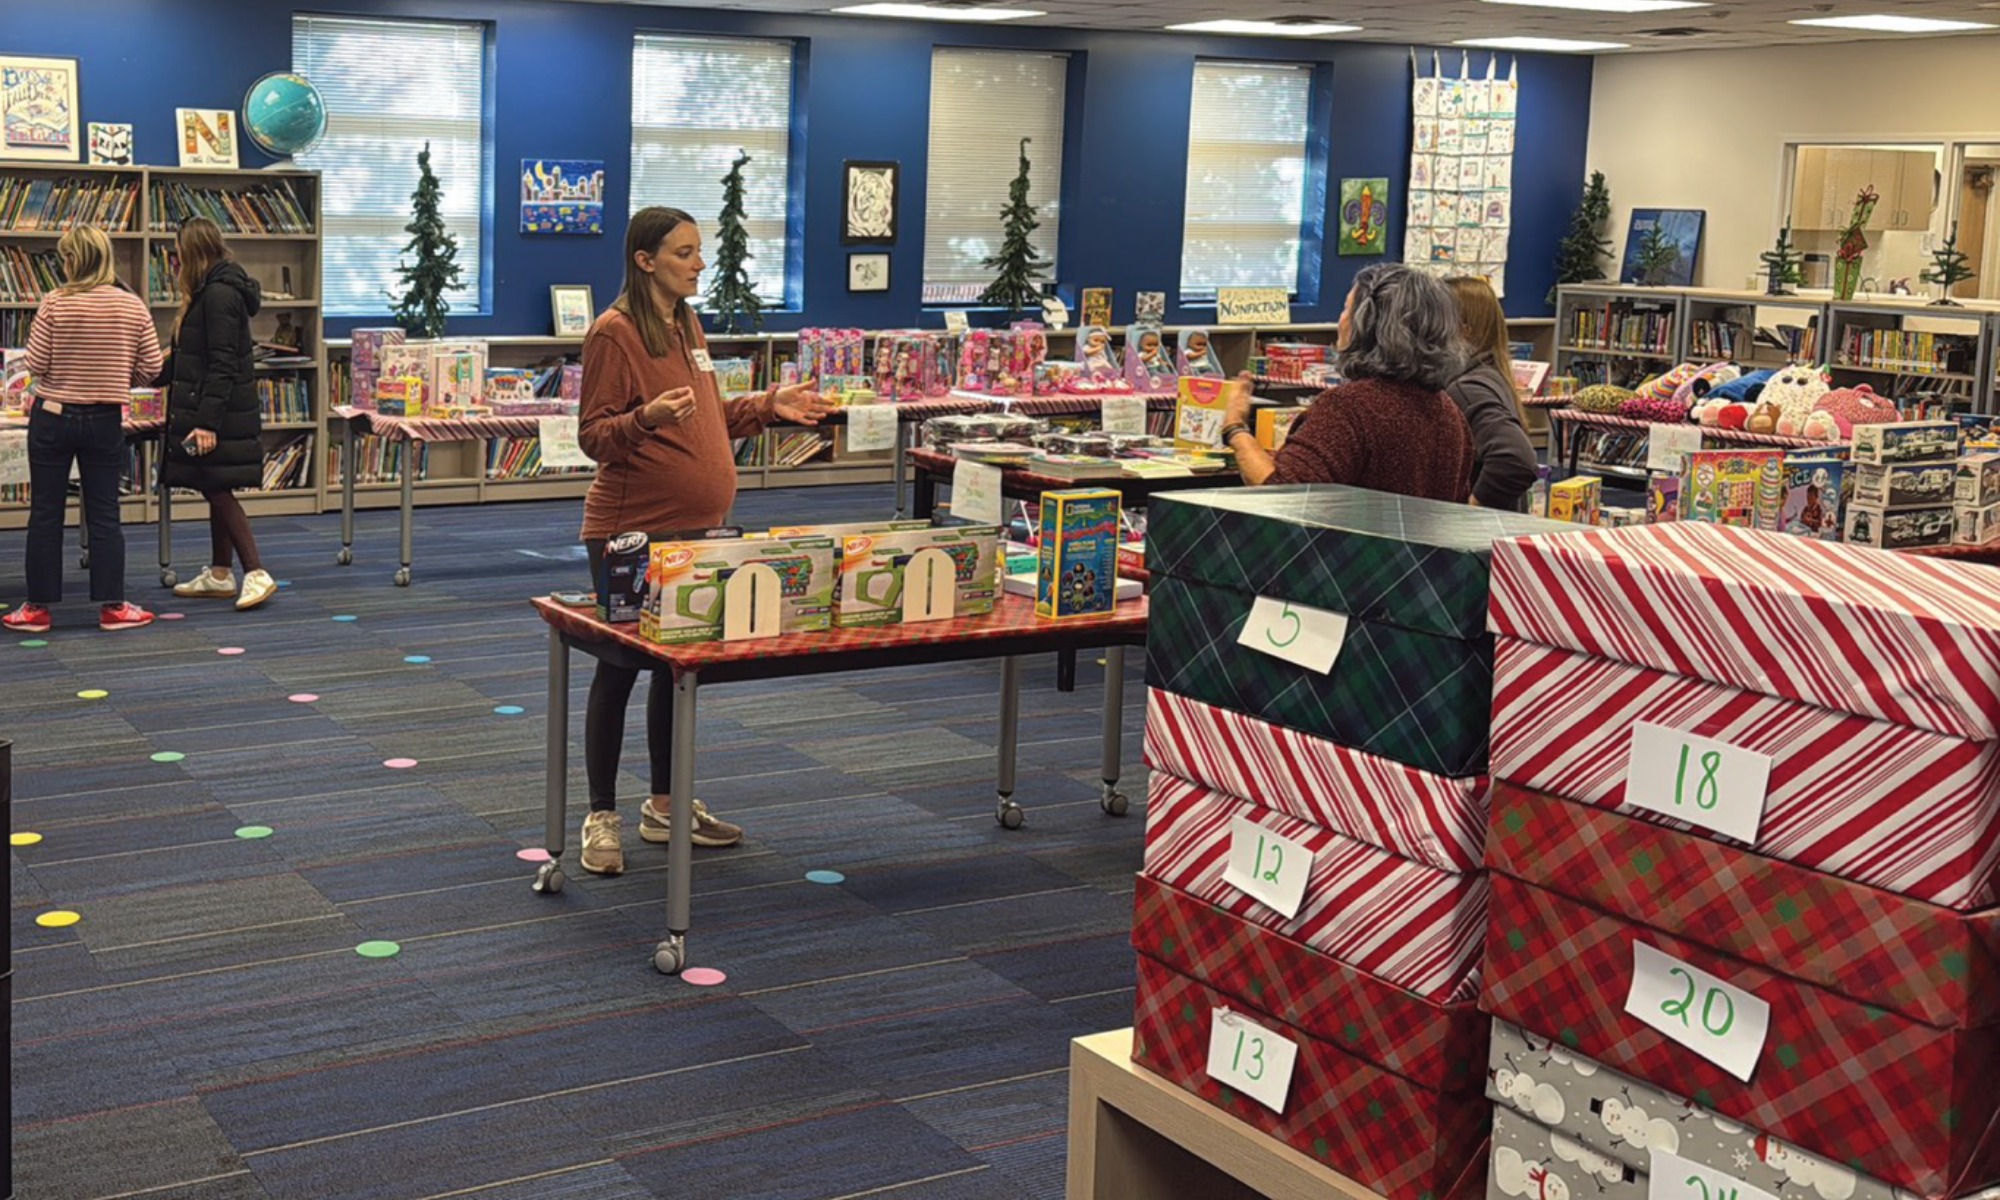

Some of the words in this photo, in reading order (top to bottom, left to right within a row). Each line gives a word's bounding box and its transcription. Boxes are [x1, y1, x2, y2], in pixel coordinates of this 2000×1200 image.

[1790, 470, 1811, 486] ICE
[607, 532, 648, 554] NERF
[664, 551, 692, 566] NERF
[1266, 601, 1300, 648] 5
[1675, 744, 1721, 810] 18
[1253, 835, 1283, 885] 12
[1660, 968, 1735, 1037] 20
[1232, 1030, 1264, 1081] 13
